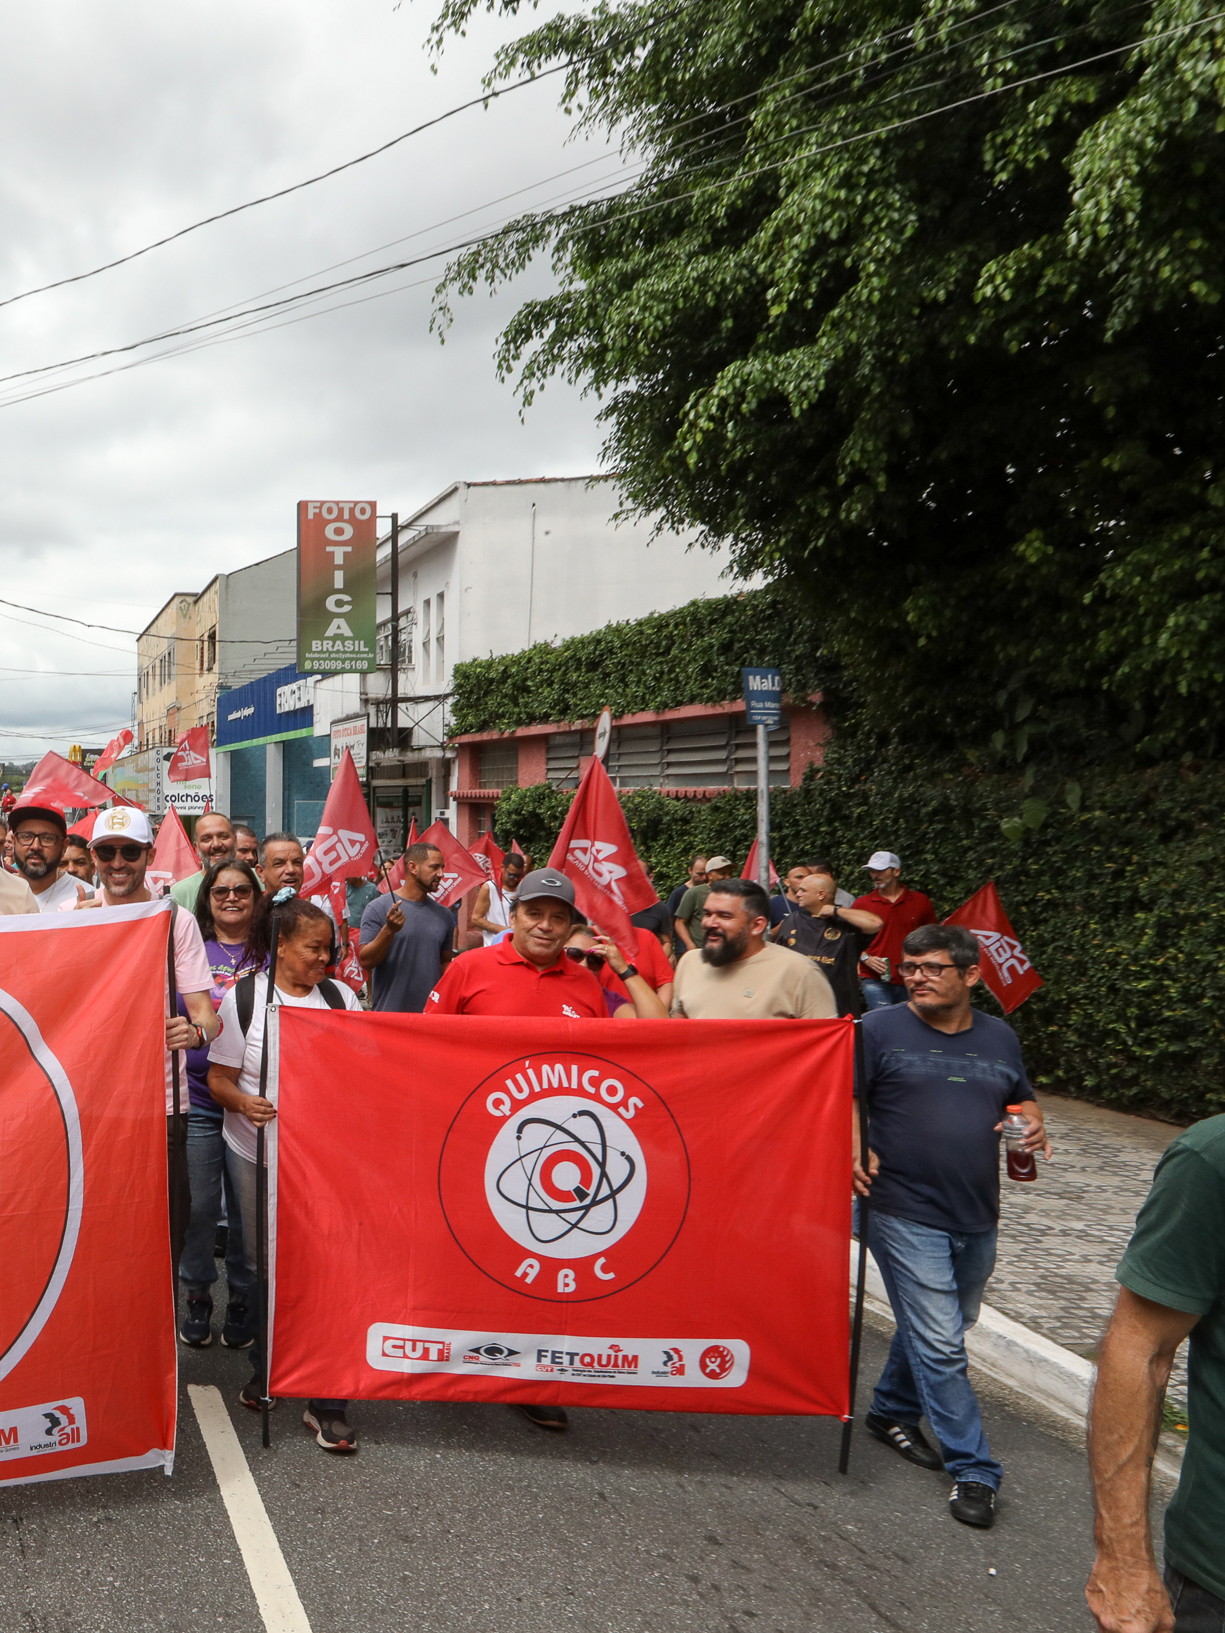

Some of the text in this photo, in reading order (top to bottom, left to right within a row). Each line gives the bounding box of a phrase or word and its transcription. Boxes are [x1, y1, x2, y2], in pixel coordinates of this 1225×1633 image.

[307, 502, 372, 520] FOTO
[311, 640, 369, 651] BRASIL
[313, 660, 368, 670] 93099-6169
[164, 791, 214, 803] colchões
[486, 1060, 644, 1119] QUÍMICOS
[383, 1339, 443, 1360] CUT
